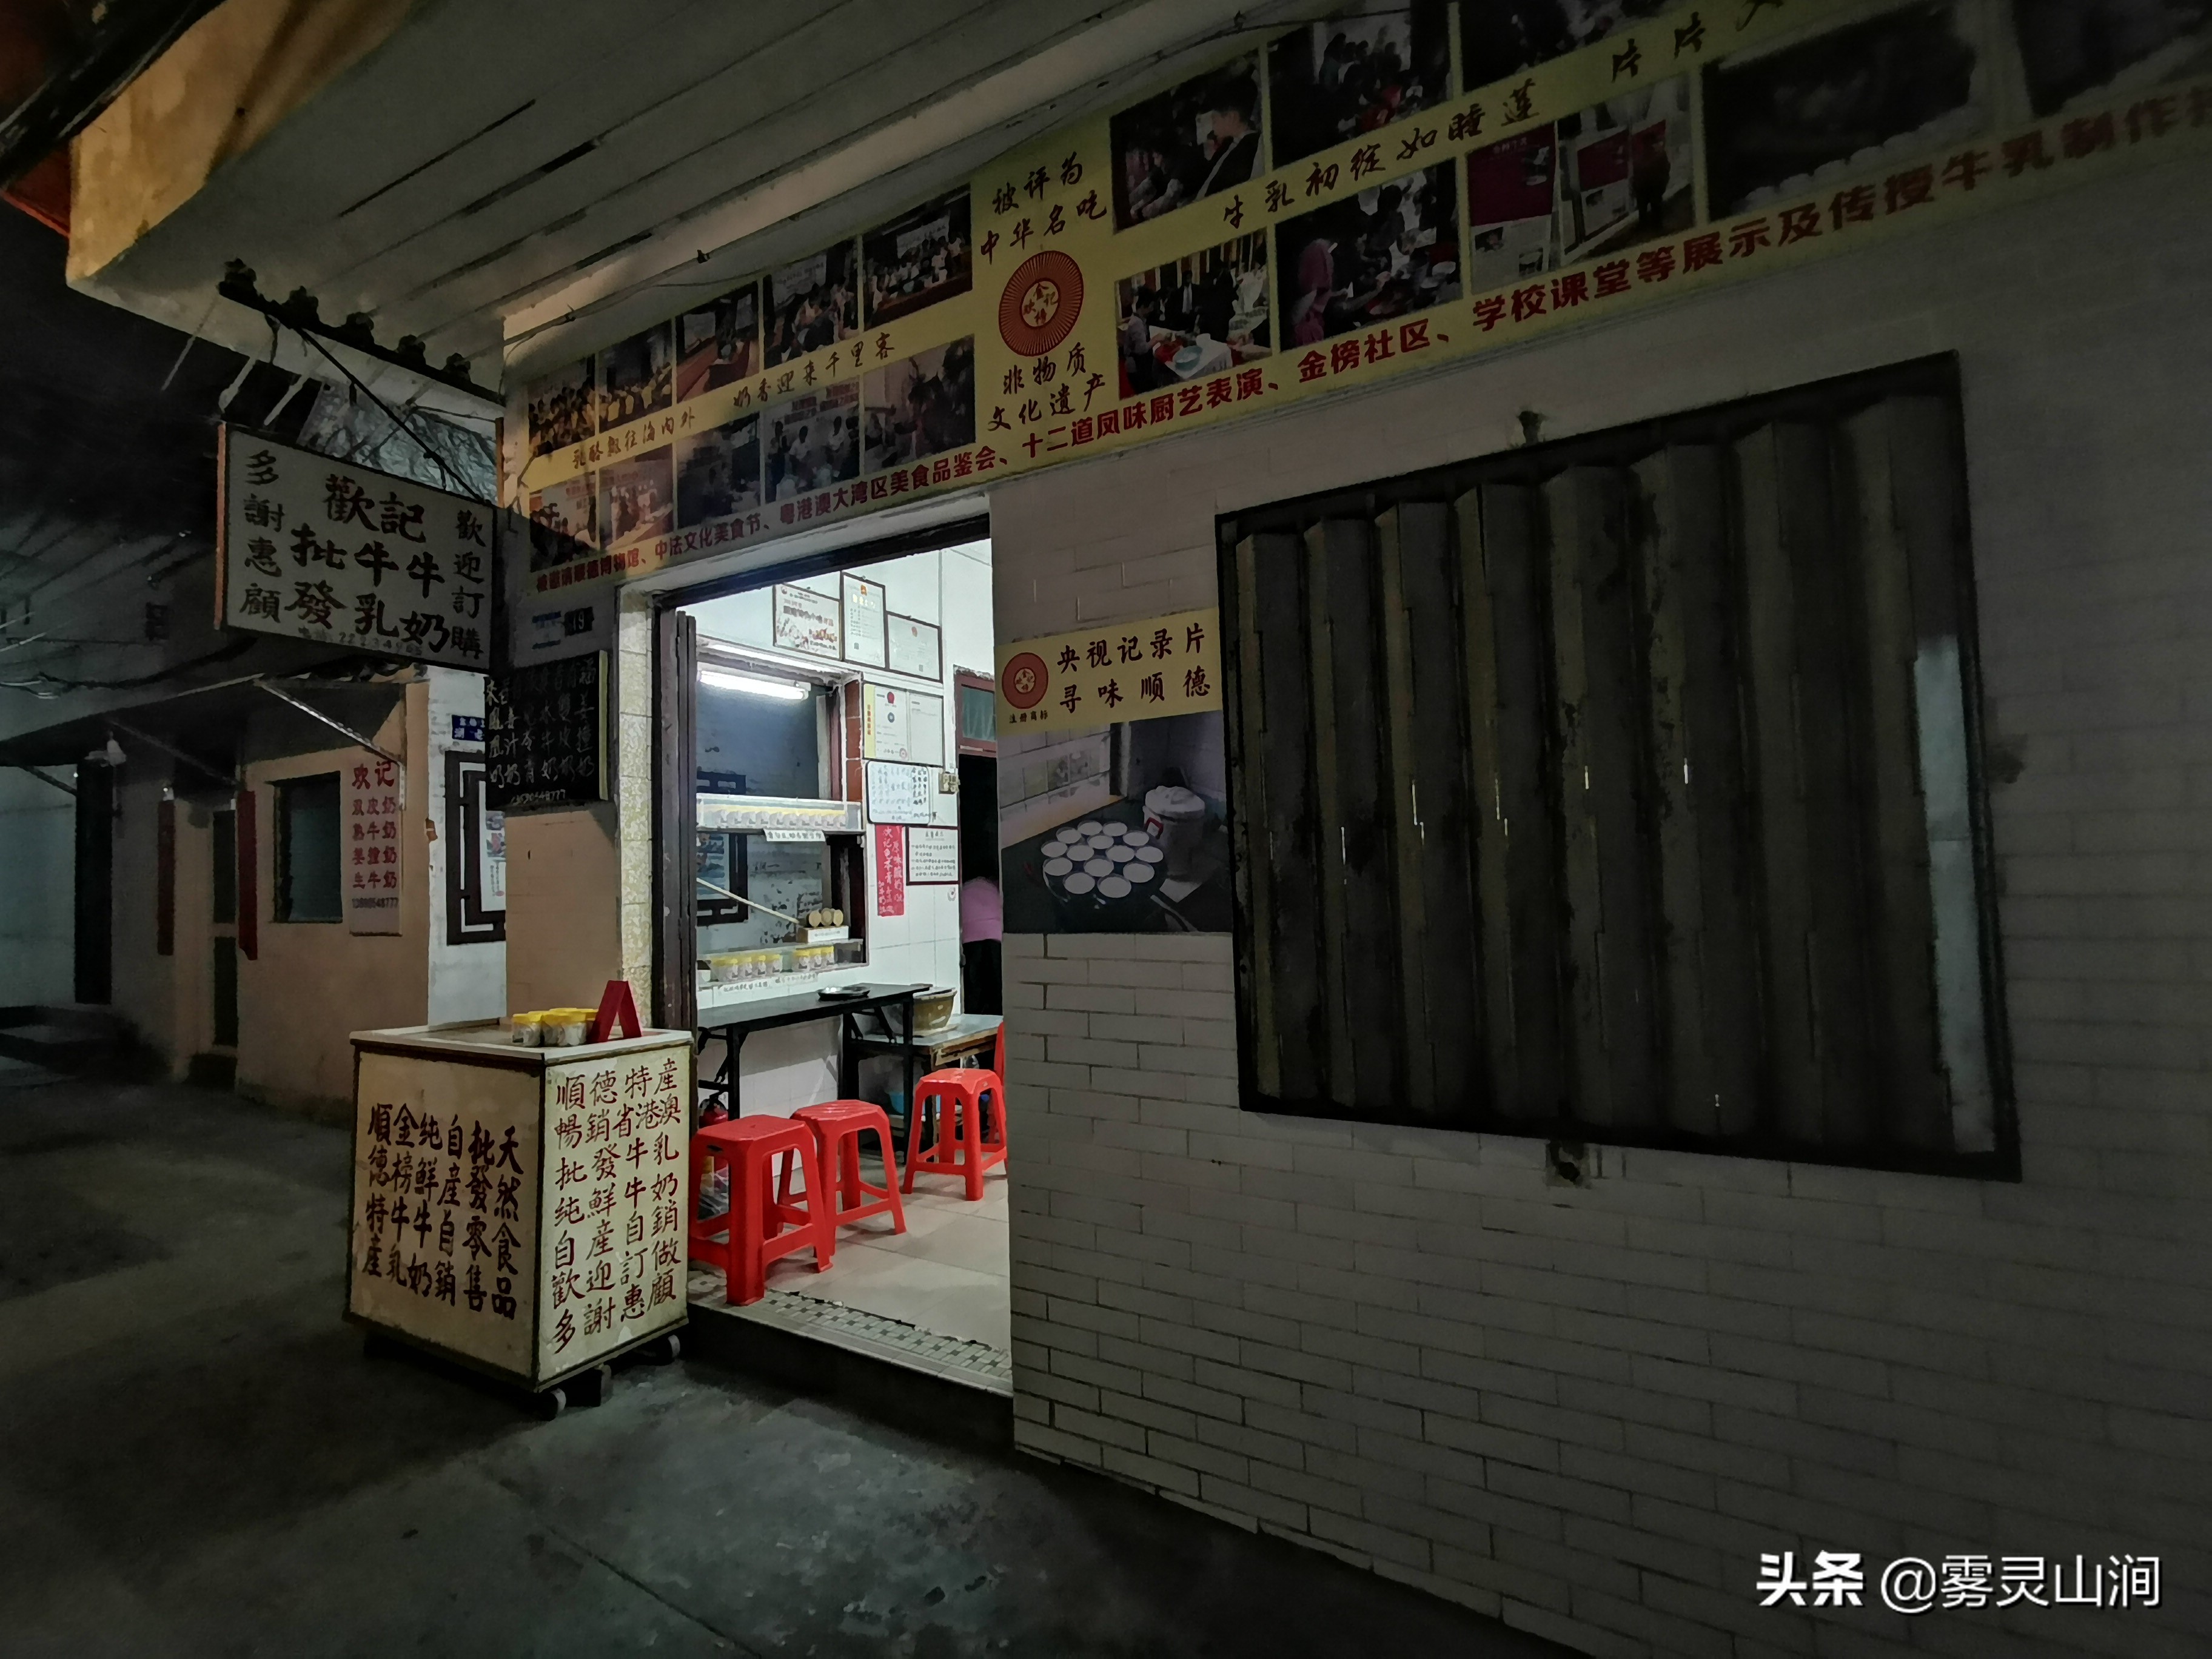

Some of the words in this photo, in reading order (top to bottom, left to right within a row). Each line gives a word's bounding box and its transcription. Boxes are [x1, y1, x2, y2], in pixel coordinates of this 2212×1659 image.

[993, 152, 1083, 215] 被评为
[980, 190, 1107, 265] 中华名吃
[1003, 341, 1088, 395] 非物质
[987, 373, 1105, 432] 文化遗产
[324, 474, 426, 543] 歡記
[1057, 622, 1205, 674] 央视记录片
[1060, 665, 1210, 714] 寻味顺德
[352, 760, 395, 790] 欢记
[555, 1131, 679, 1191] 批發牛乳
[491, 1125, 523, 1321] 天然食品
